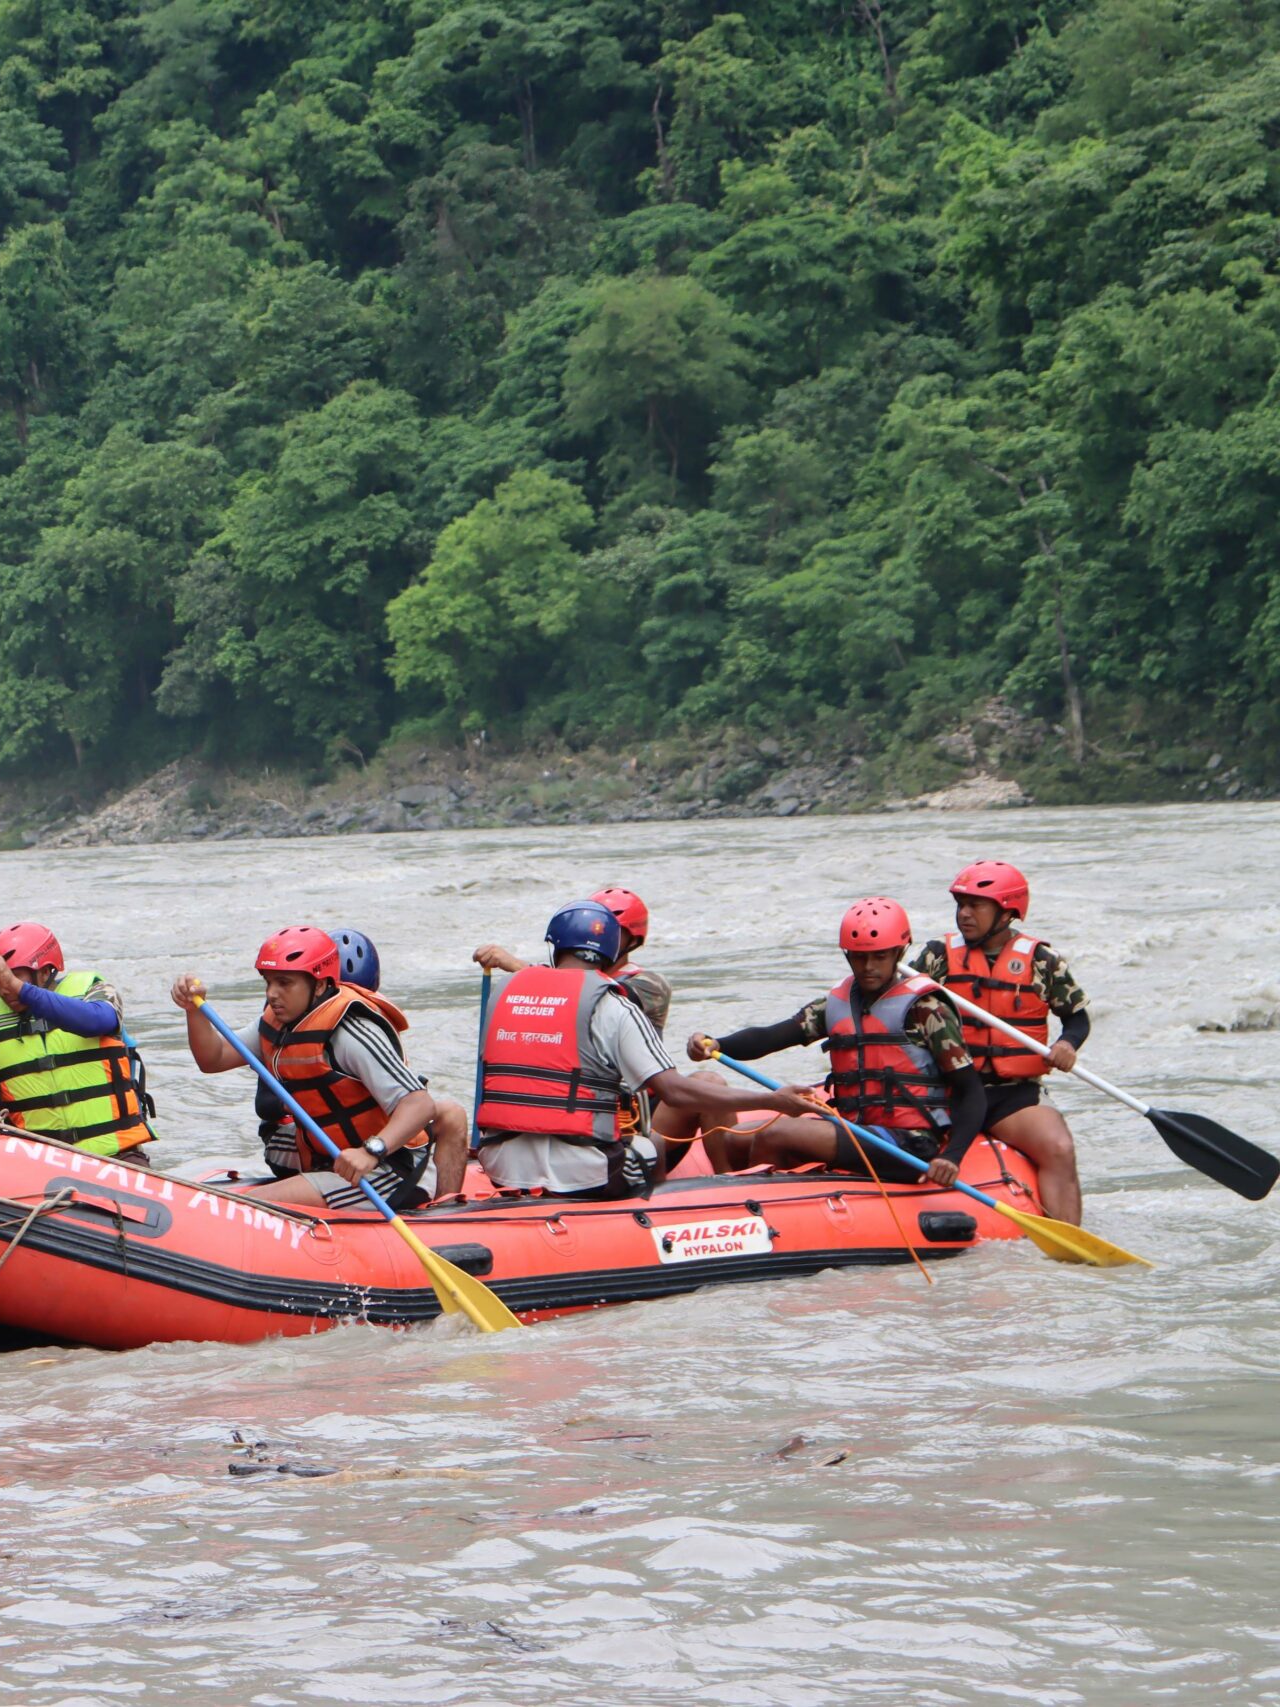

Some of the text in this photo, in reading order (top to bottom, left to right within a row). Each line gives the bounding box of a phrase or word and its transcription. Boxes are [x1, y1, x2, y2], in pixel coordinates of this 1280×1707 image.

[506, 995, 568, 1006] NEPALI ARMY
[512, 1006, 555, 1016] RESCUER
[5, 1137, 309, 1249] NEPALI ARMY
[664, 1222, 758, 1242] SAILSKI
[684, 1241, 743, 1257] HYPALON
